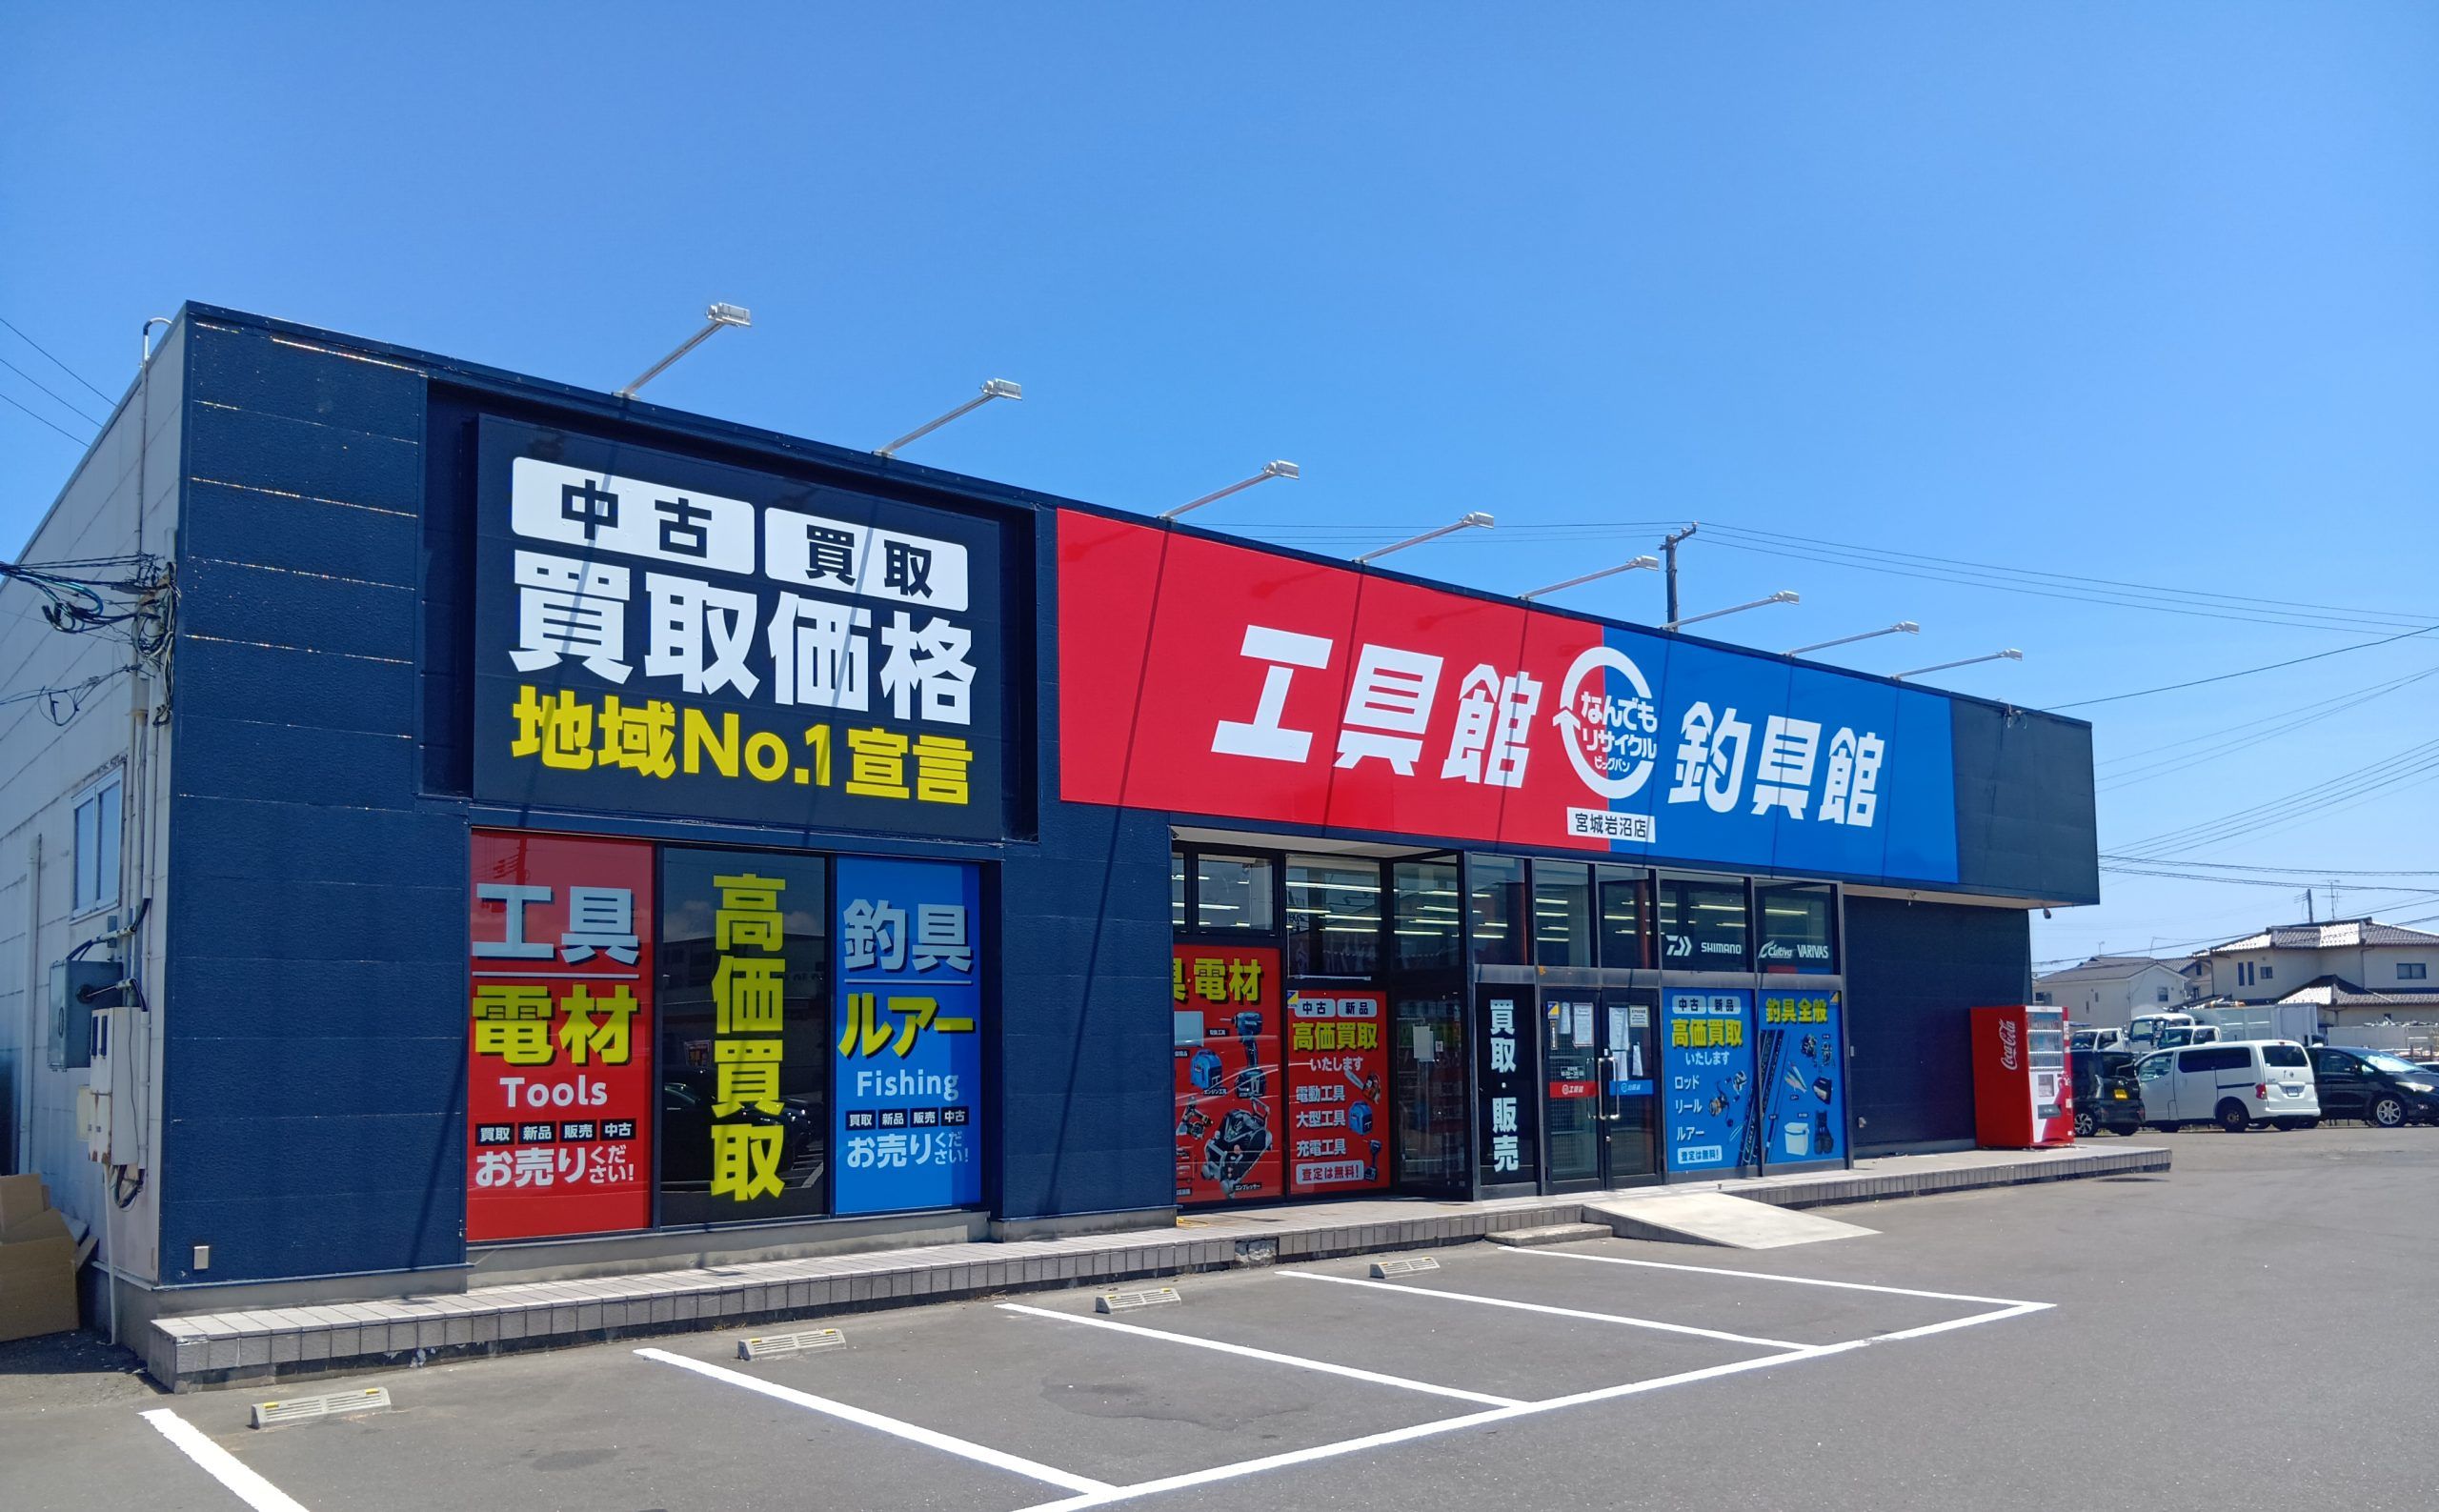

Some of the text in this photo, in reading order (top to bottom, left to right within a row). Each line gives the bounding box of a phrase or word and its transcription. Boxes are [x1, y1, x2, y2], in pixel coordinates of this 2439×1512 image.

[560, 478, 713, 560] 中古
[805, 523, 933, 599] 買取
[509, 549, 978, 726] 買取価格
[1210, 624, 1543, 789] 工具館
[1581, 691, 1658, 734] なんでも
[511, 684, 974, 805] 地域No.1宣言
[1582, 728, 1658, 759] リサイクル
[1667, 699, 1886, 828] 釣具館
[1575, 813, 1647, 838] 宮城岩沼店
[472, 882, 639, 965] 工具
[843, 898, 972, 972] 釣具
[1701, 941, 1742, 955] SHIMANO
[1797, 944, 1828, 958] VARIVAS
[1302, 1001, 1326, 1015] 中古
[1345, 1001, 1369, 1015] 新品
[1678, 998, 1699, 1012] 中古
[1714, 998, 1734, 1012] 新品
[1765, 997, 1828, 1023] 釣具全般
[472, 984, 638, 1065] 電材
[710, 873, 786, 1201] 高価買取
[838, 992, 975, 1058] ルアー
[1292, 1021, 1379, 1051] 高価買取
[1670, 1018, 1743, 1048] 高価買取
[1310, 1056, 1364, 1072] いたします
[1685, 1051, 1730, 1065] いたします
[499, 1075, 608, 1108] Tools
[857, 1069, 959, 1101] Fishing
[1296, 1084, 1346, 1102] 電動工具
[1489, 998, 1520, 1174] 買取・販売
[1674, 1074, 1700, 1090] ロッド
[849, 1109, 966, 1127] 買取 新品 販売 中古
[1296, 1110, 1346, 1128] 大型工具
[1675, 1099, 1703, 1114] リール
[479, 1122, 633, 1142] 買取 新品 販売 中古
[1677, 1126, 1705, 1141] ルアー
[847, 1133, 932, 1169] お売り
[1296, 1138, 1347, 1158] 充電工具
[476, 1147, 587, 1188] お売り
